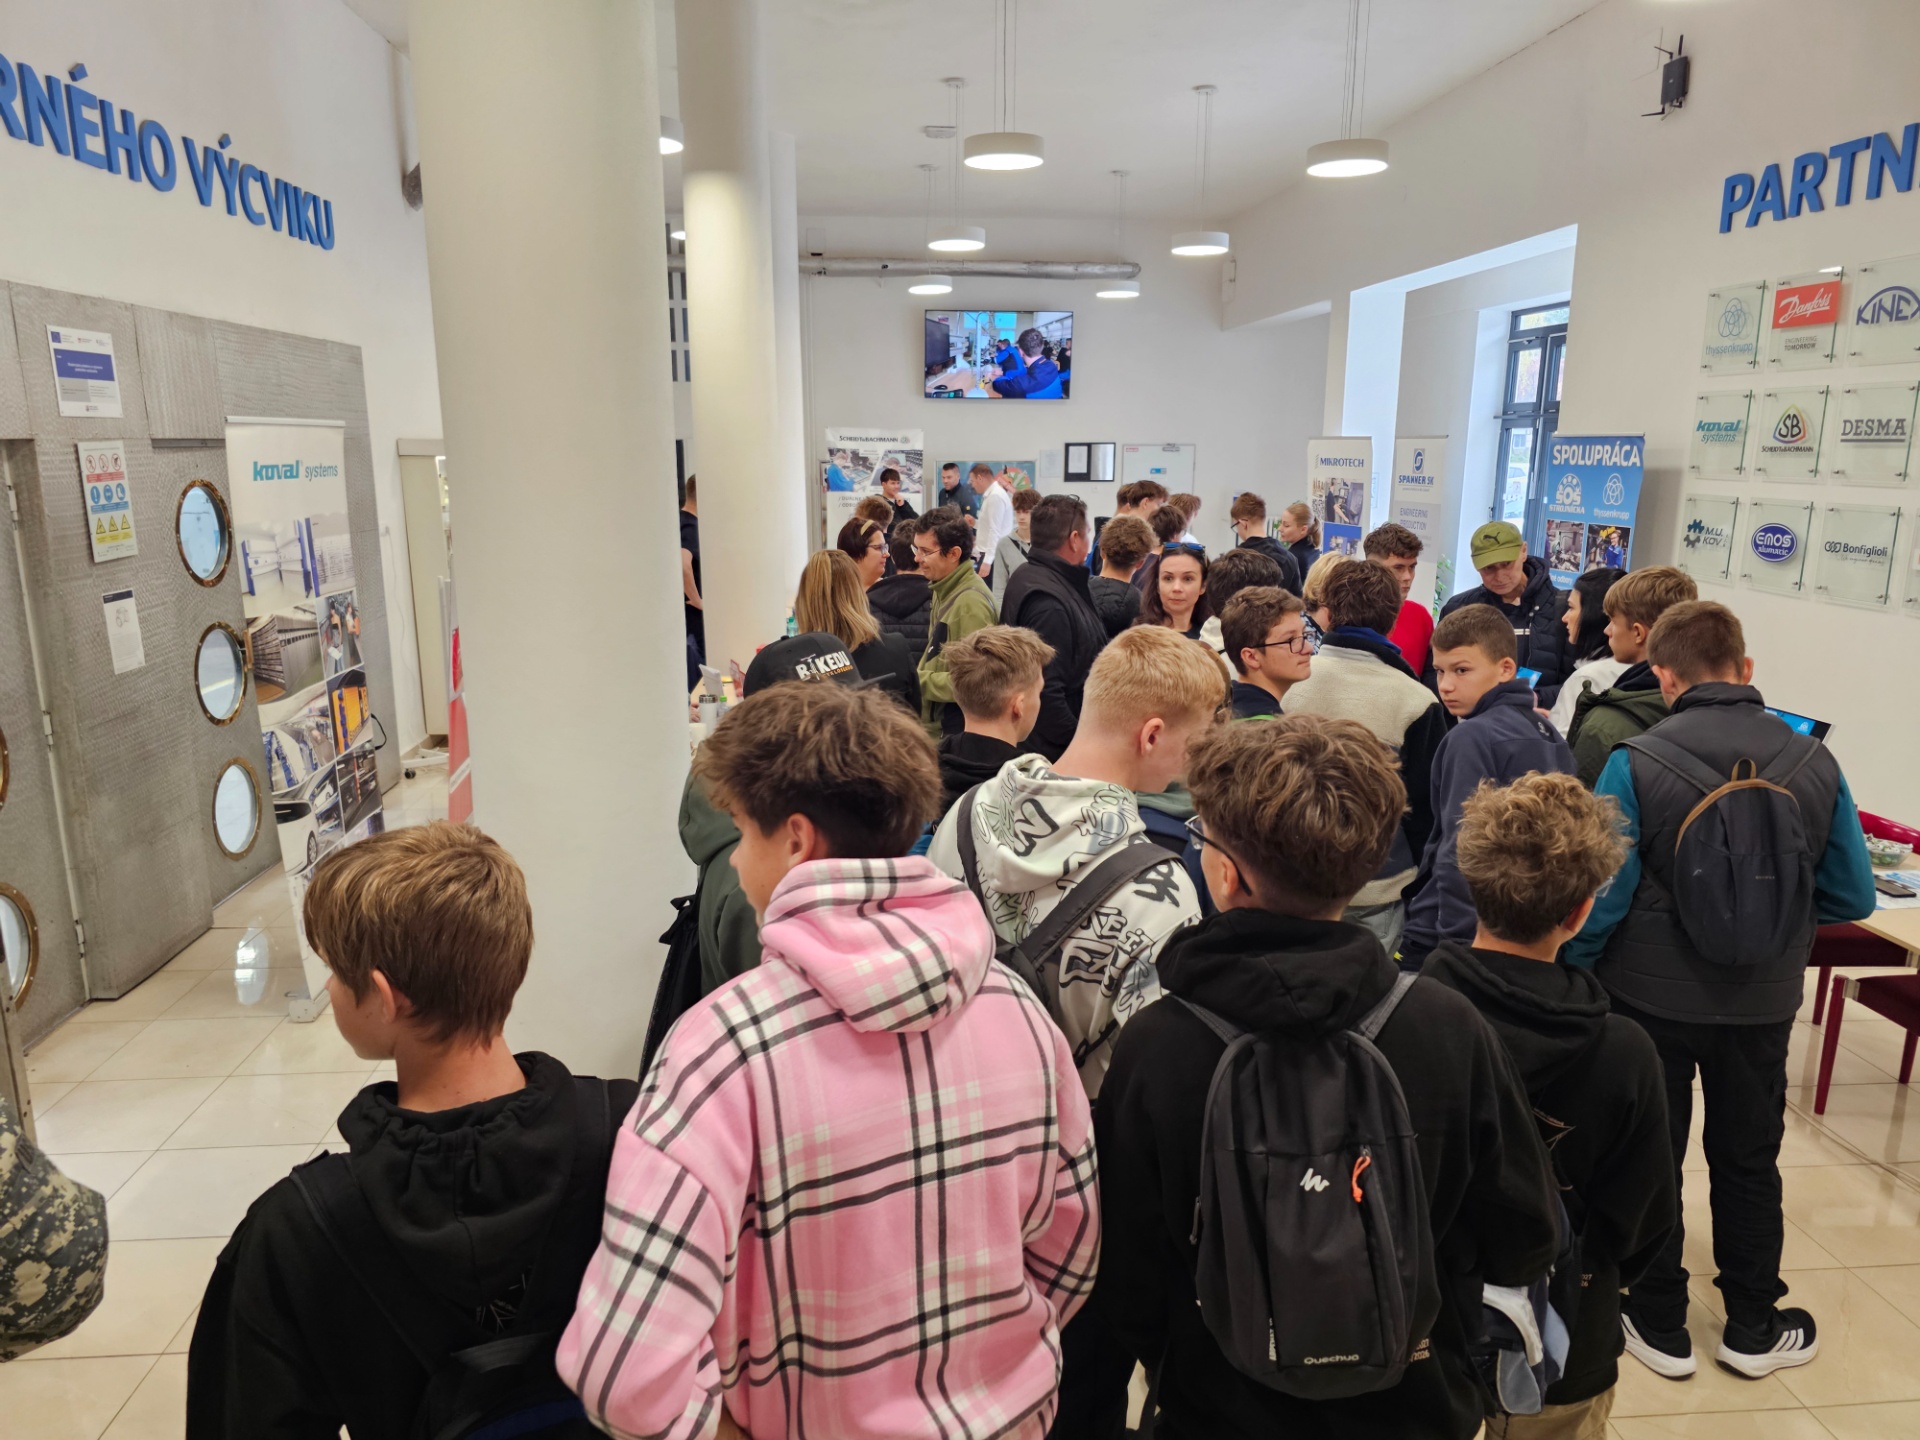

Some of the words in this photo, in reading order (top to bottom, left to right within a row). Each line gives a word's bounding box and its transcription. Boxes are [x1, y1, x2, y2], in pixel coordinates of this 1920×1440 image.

[1718, 122, 1920, 234] PARTN
[182, 133, 335, 250] VÝCVIKU
[1779, 287, 1833, 324] Danfoss
[1784, 336, 1818, 344] ENGINEERING
[1705, 343, 1753, 356] thyssenkrupp
[1784, 343, 1817, 351] TOMORROW
[1696, 419, 1741, 431] koval
[1840, 418, 1907, 437] DESMA
[1701, 433, 1737, 443] systems
[1552, 441, 1641, 467] SPOLUPRÁCA
[1320, 457, 1365, 468] MIKROTECH
[252, 460, 300, 481] koval
[305, 463, 339, 482] systems
[1398, 475, 1426, 485] SPANNER
[1399, 507, 1429, 518] ENGINEERING
[1593, 508, 1630, 520] thyssenkrupp
[1702, 537, 1722, 545] KOV
[1842, 543, 1888, 558] Bonfiglioli
[1304, 1353, 1360, 1365] Quechua
